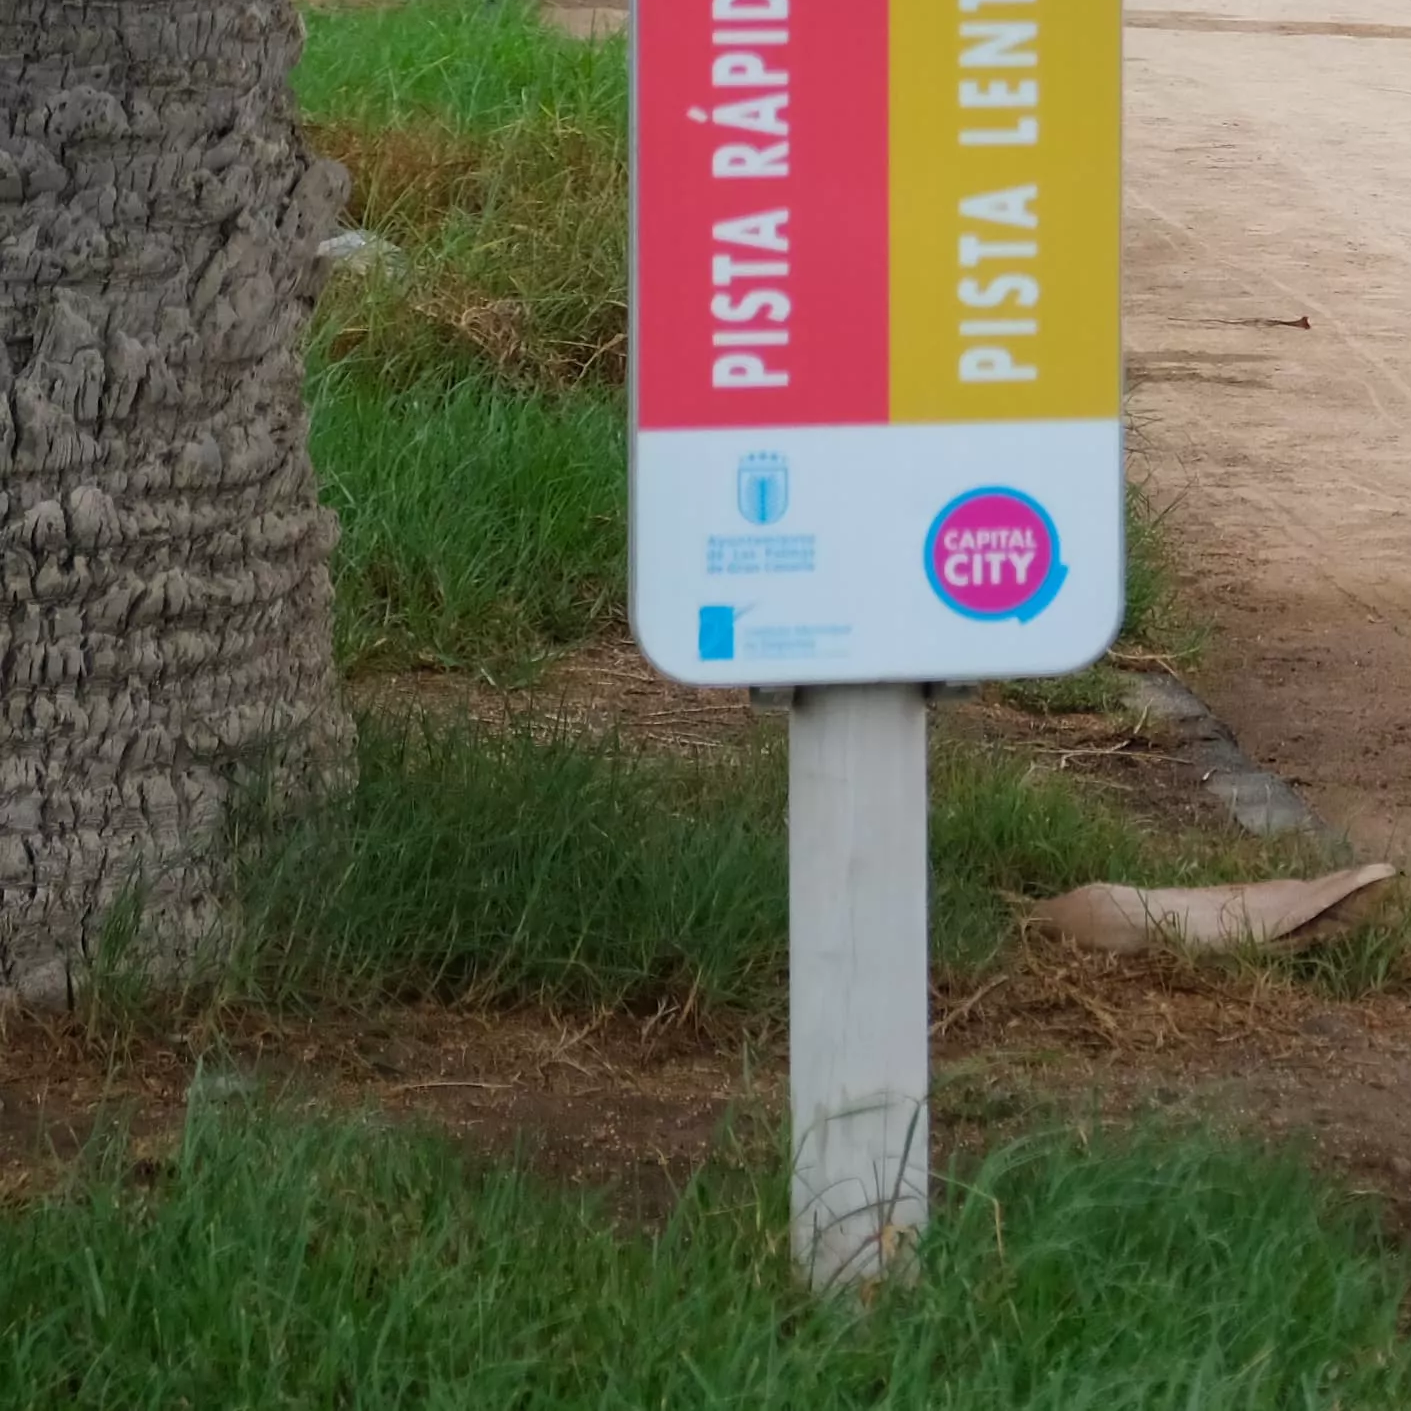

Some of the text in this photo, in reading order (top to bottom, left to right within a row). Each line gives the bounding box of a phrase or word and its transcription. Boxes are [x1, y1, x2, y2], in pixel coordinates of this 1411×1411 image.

[710, 208, 790, 389] PISTA
[957, 184, 1039, 383] PISTA
[943, 527, 1037, 551] CAPITAL
[943, 551, 1036, 587] CITY
